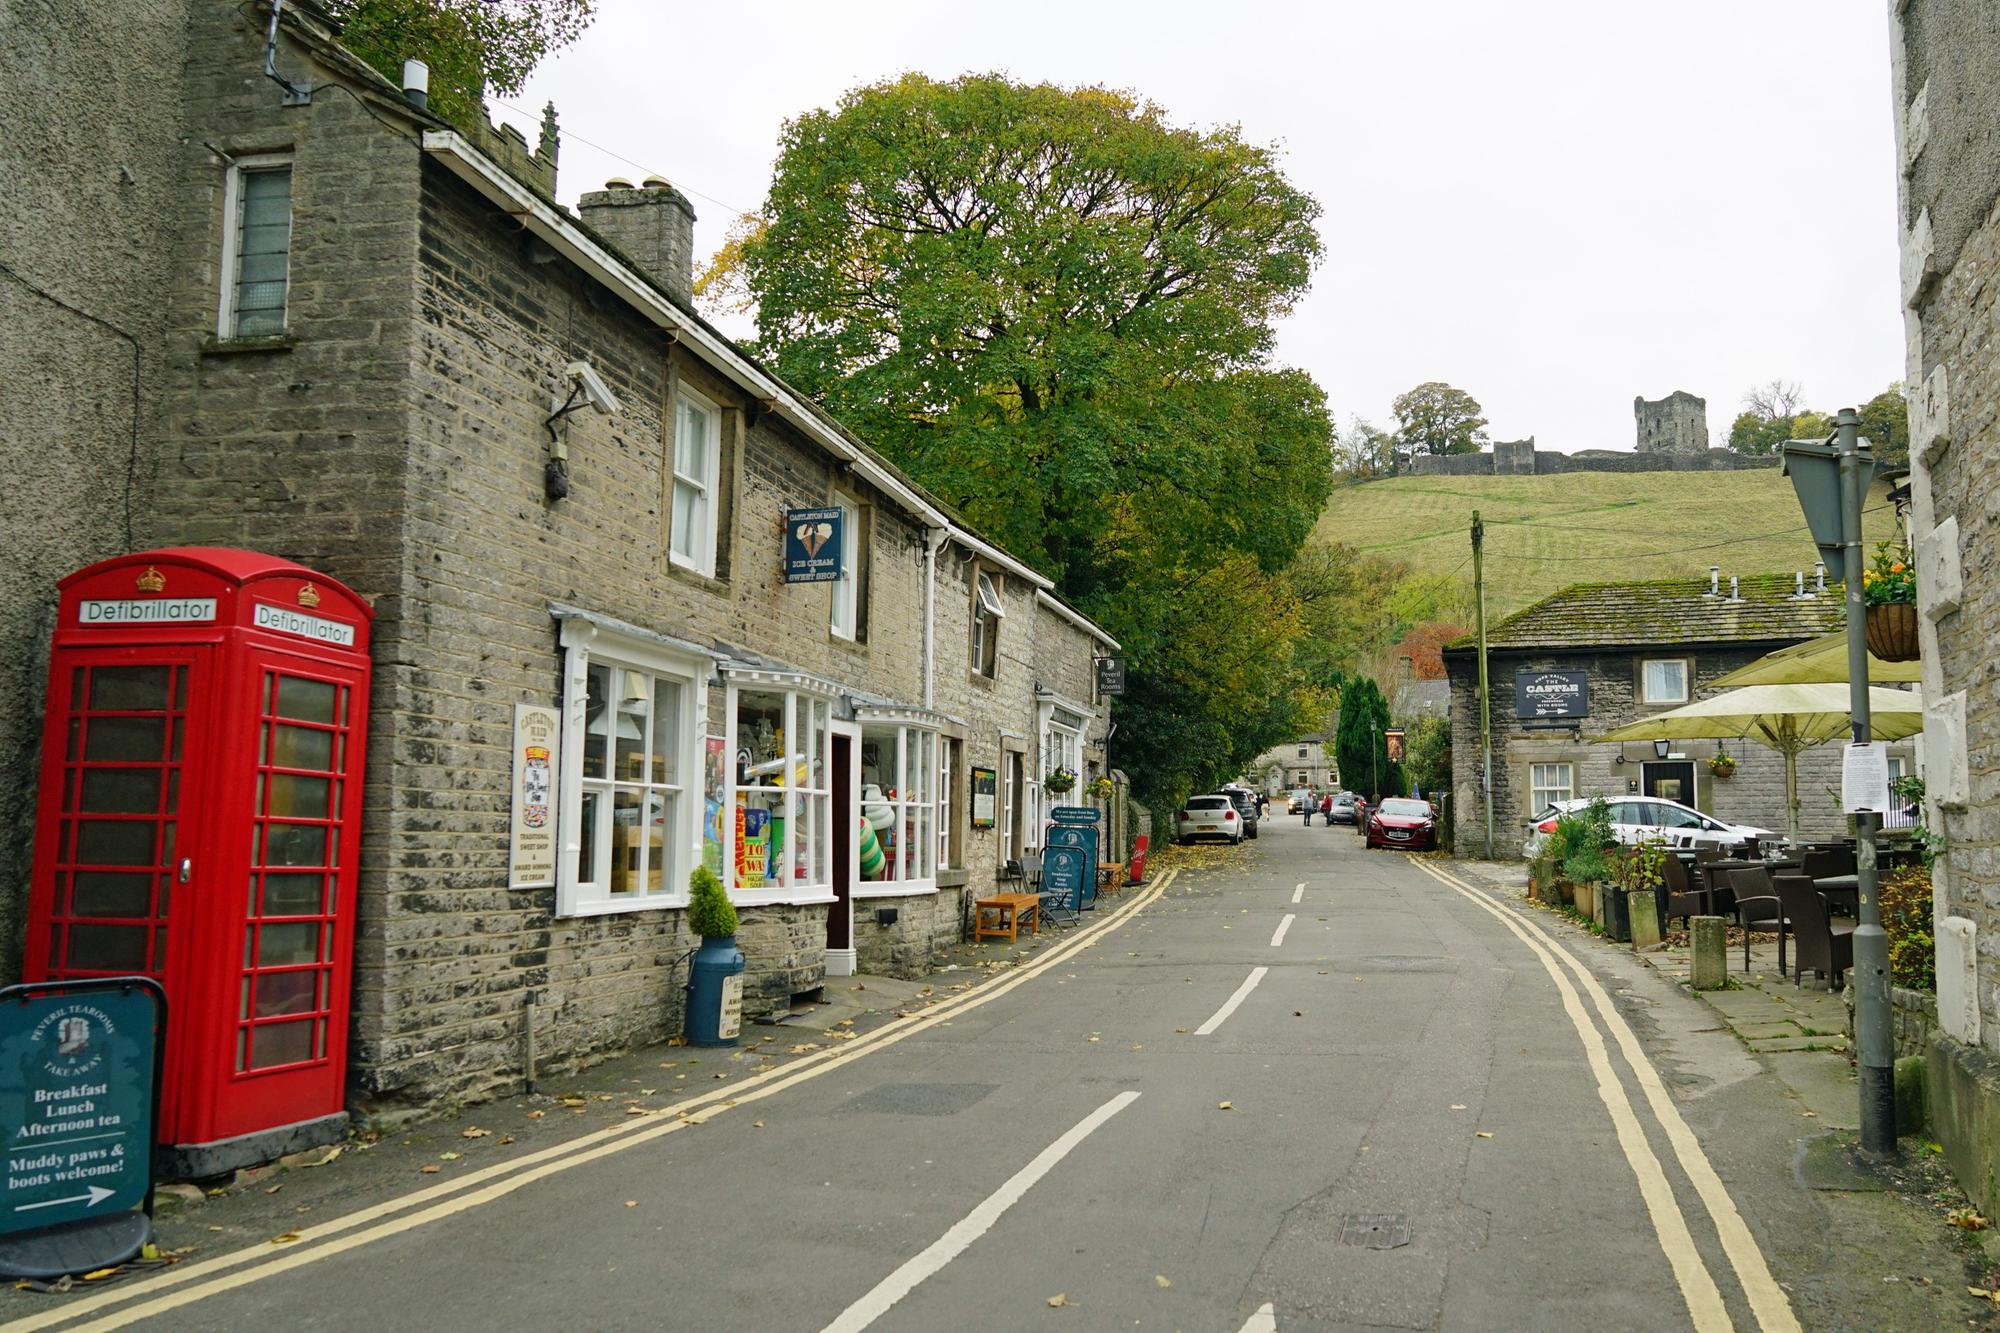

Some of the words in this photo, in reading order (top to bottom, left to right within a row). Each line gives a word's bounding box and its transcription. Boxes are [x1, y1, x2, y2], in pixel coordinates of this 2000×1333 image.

[807, 558, 834, 567] CREAM
[88, 602, 211, 620] Defibrillator
[258, 606, 348, 643] Defibrillator
[1526, 684, 1579, 693] CASTLE
[1550, 674, 1569, 682] VALLEY
[31, 1008, 67, 1041] PEVERIL
[70, 1005, 115, 1034] TEAROOMS
[44, 1061, 70, 1077] TAKE
[72, 1054, 102, 1076] AWAY
[34, 1082, 108, 1103] Breakfast
[46, 1100, 95, 1118] Lunch
[16, 1119, 95, 1138] Afternoon
[99, 1115, 120, 1126] tea
[9, 1154, 66, 1172] Muddy
[69, 1148, 107, 1167] paws
[110, 1143, 124, 1156] &
[8, 1172, 50, 1190] boots
[55, 1160, 124, 1182] welcome!
